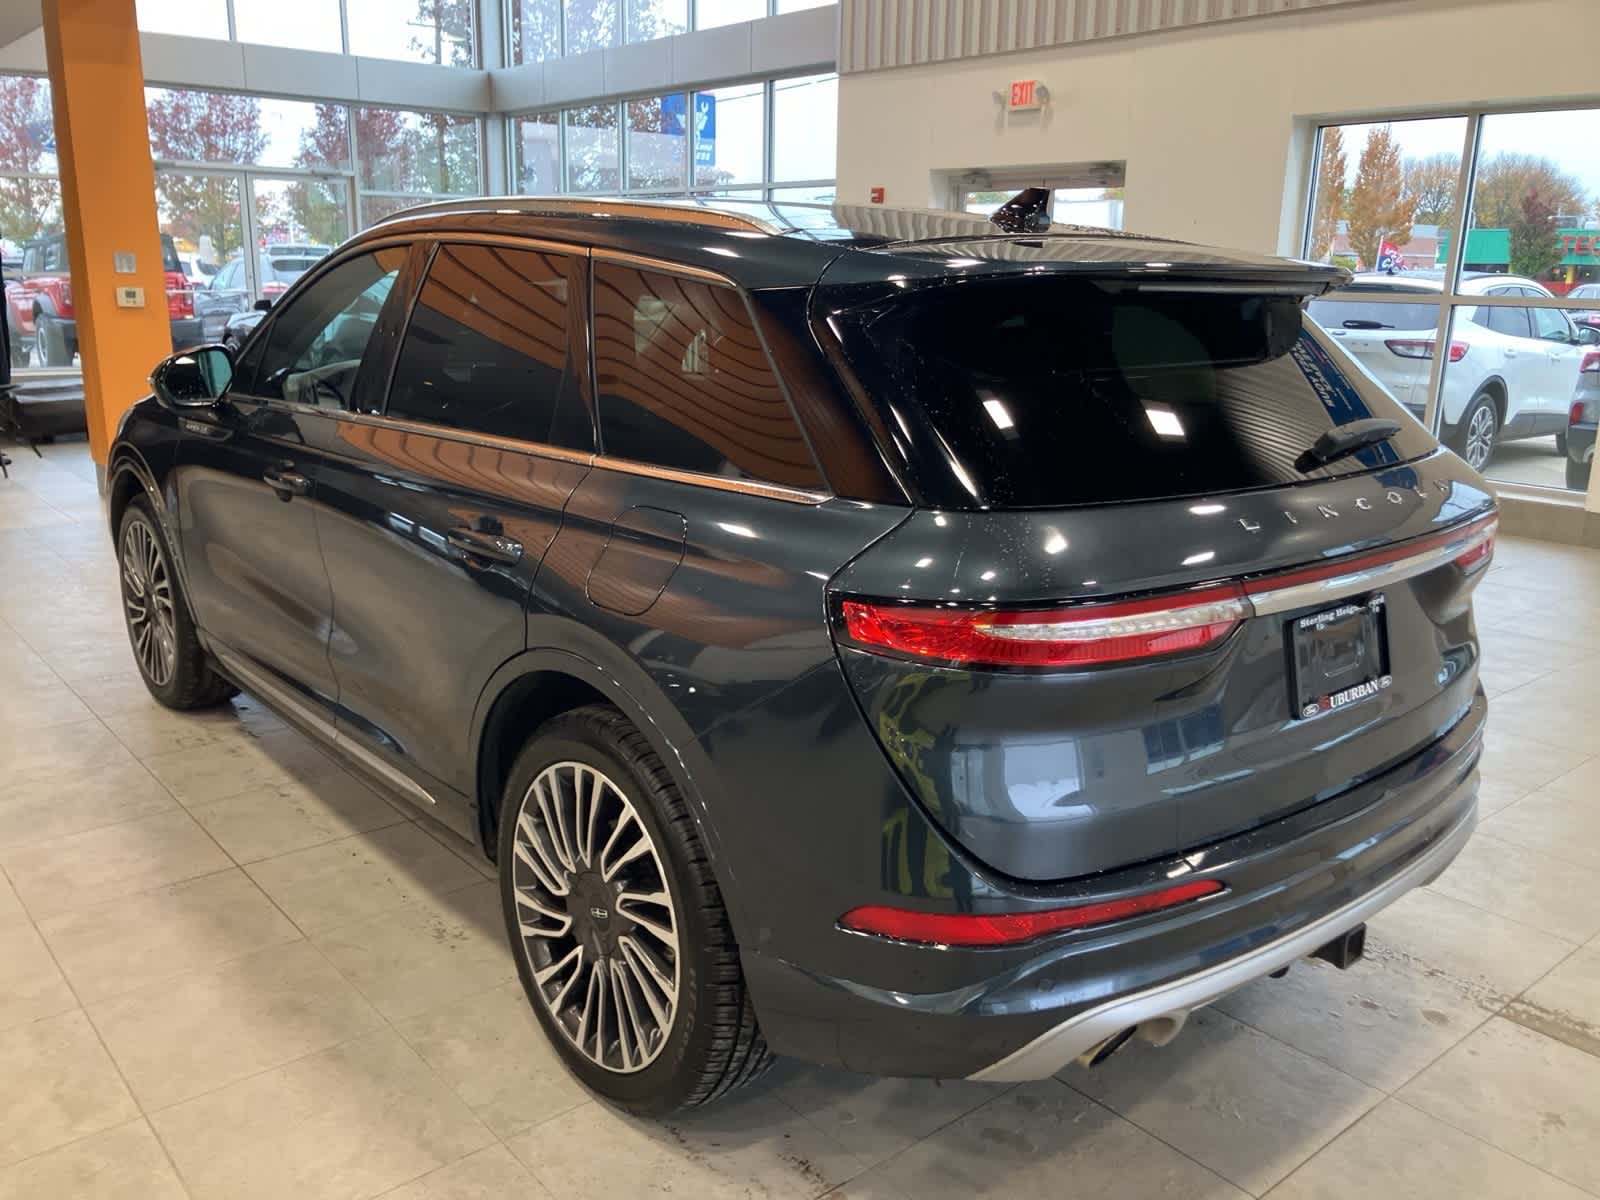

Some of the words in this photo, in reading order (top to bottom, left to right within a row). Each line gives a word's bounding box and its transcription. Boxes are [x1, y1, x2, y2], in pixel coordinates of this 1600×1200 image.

[1011, 81, 1035, 106] EXIT
[1239, 480, 1449, 531] LINCOLN
[1300, 611, 1335, 628] Sterling
[1319, 680, 1379, 709] SUBURBAN
